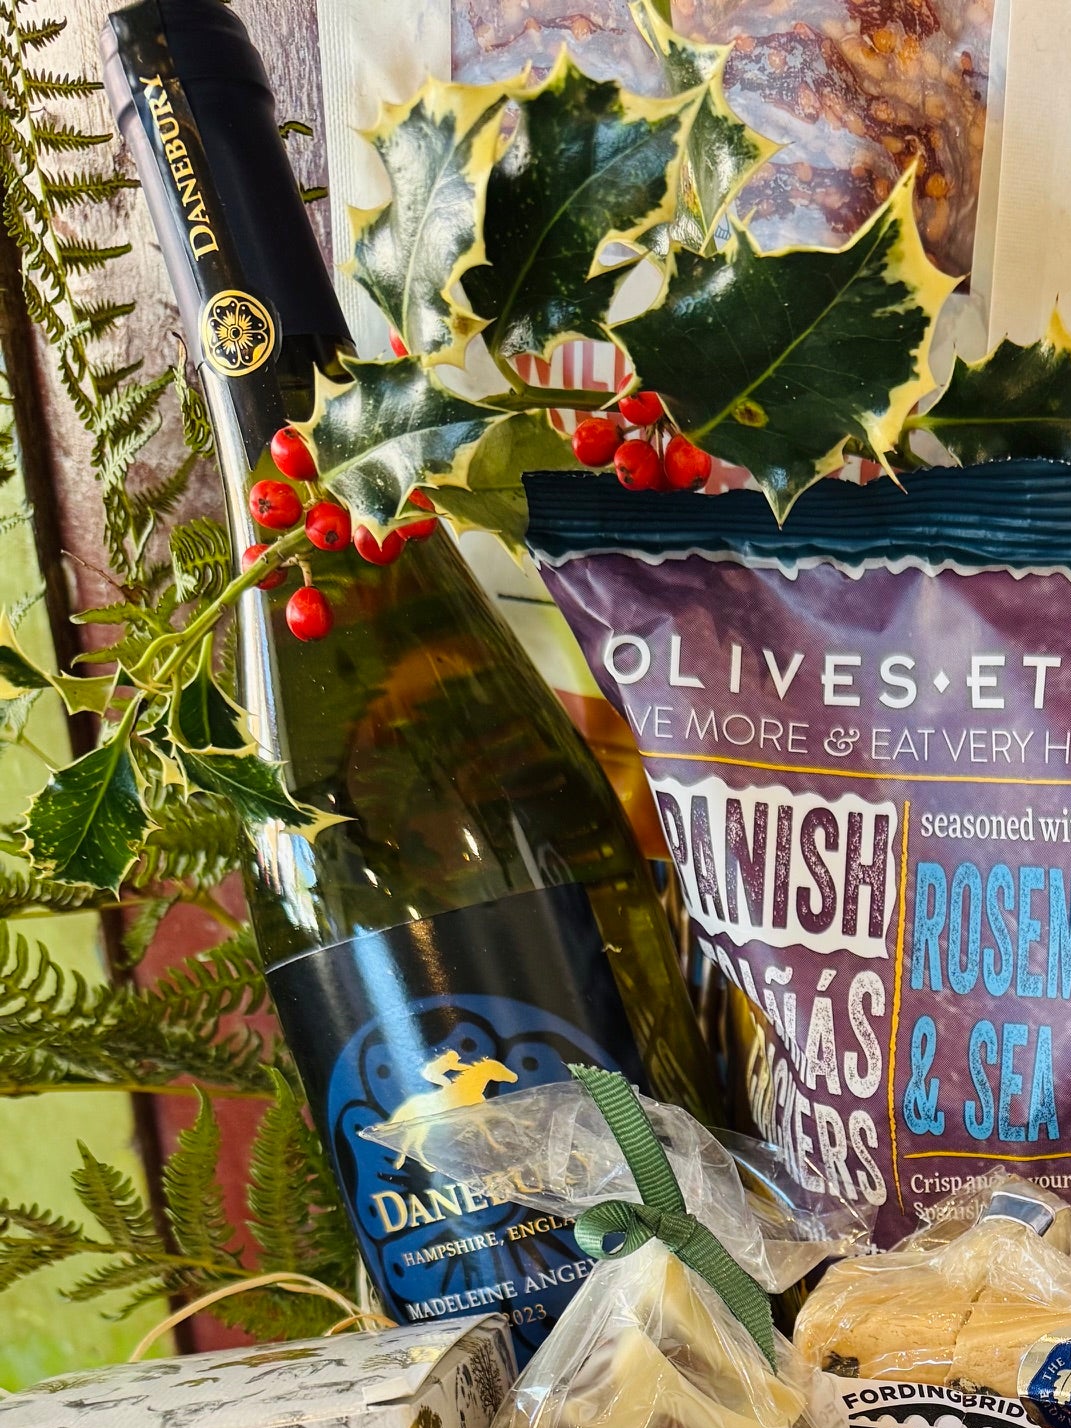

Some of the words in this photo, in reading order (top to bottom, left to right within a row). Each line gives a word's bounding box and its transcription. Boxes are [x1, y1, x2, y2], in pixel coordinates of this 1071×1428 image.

[139, 73, 219, 262] DANEBURY
[685, 708, 810, 753] MORE
[823, 727, 860, 758] &
[871, 729, 936, 760] EAT
[944, 728, 1034, 764] VERY
[921, 809, 1035, 841] seasoned
[904, 1018, 945, 1139] &
[964, 1020, 1060, 1142] SEA
[911, 1172, 962, 1195] Crisp
[403, 1232, 504, 1266] HAMPSHIRE,
[406, 1280, 518, 1321] MADELEINE
[507, 1303, 548, 1328] 2023
[1043, 1357, 1065, 1381] THE
